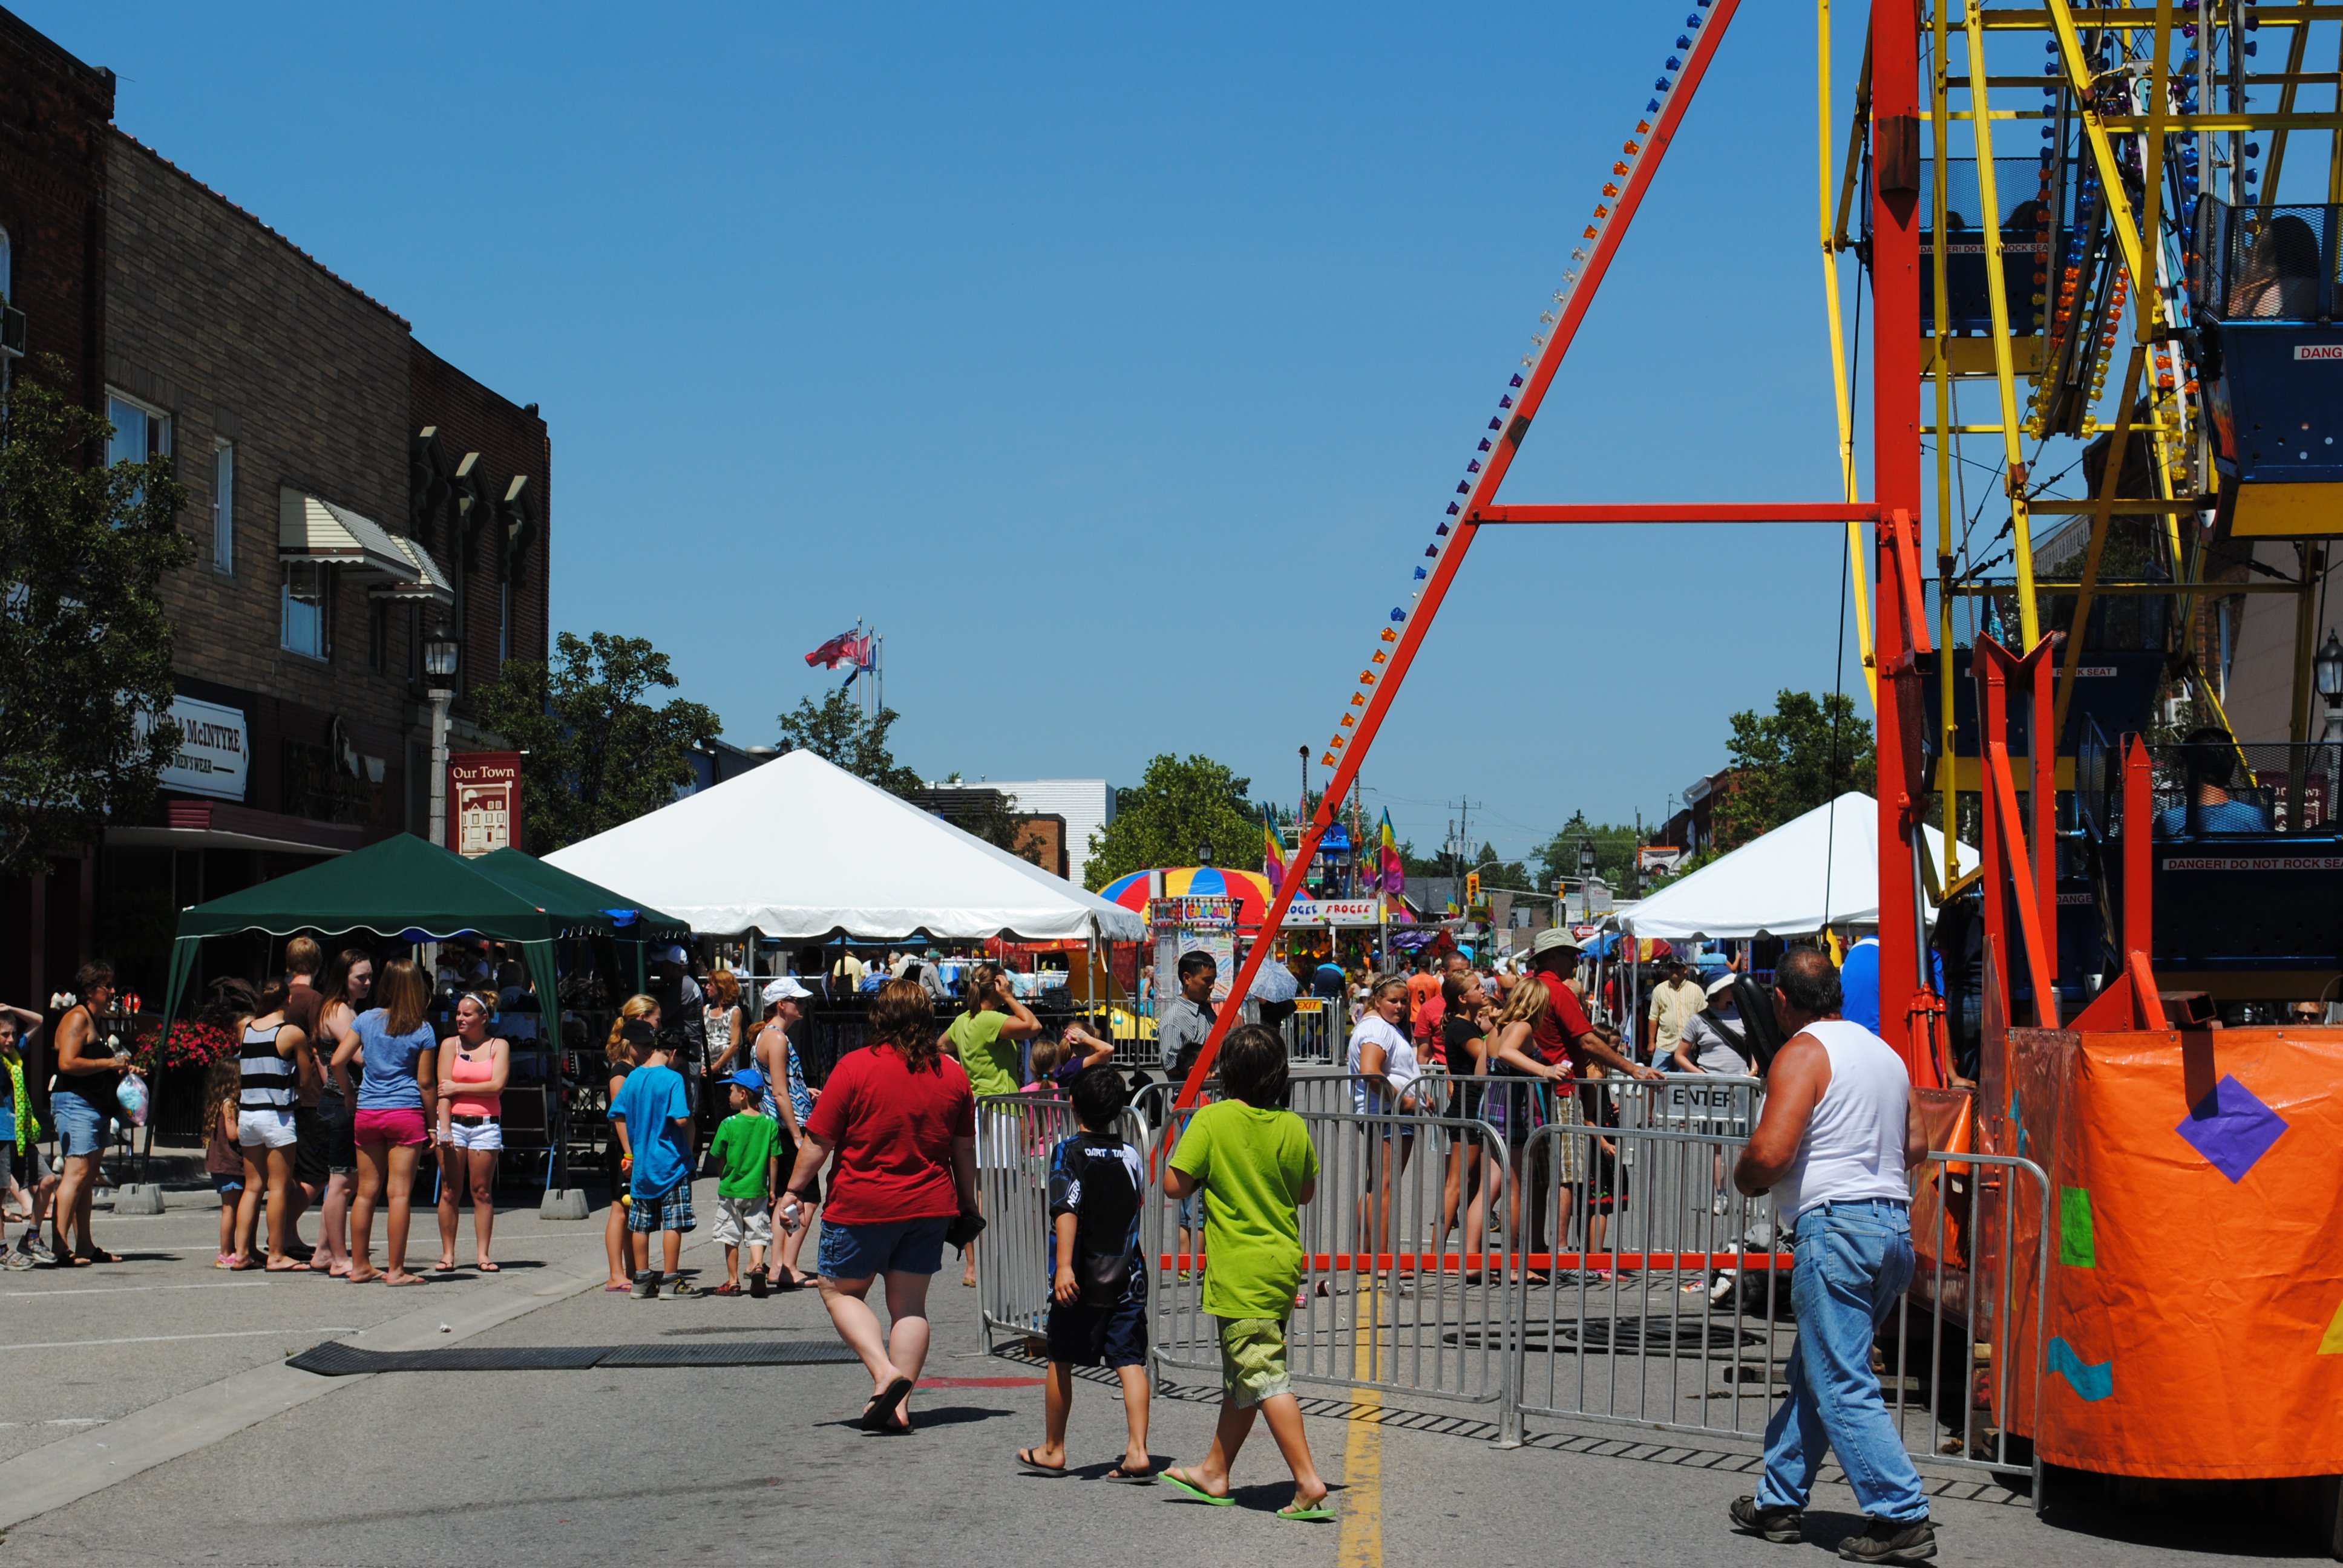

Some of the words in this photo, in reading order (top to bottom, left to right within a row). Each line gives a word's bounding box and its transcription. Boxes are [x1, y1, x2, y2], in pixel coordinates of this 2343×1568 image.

[2301, 347, 2342, 359] DANG
[187, 718, 240, 753] McINTYRE
[174, 753, 194, 771] MEN'S
[194, 757, 212, 774] WEAR
[453, 766, 477, 779] Our
[480, 766, 514, 778] Town
[2168, 860, 2226, 869] DANGER!
[2230, 860, 2249, 869] DO
[2252, 859, 2279, 868] NOT
[2284, 858, 2320, 868] ROCK
[2324, 858, 2343, 867] SE
[1185, 903, 1231, 919] COUPONS
[1286, 904, 1318, 915] OGEE
[1325, 904, 1371, 914] FROGEE
[1417, 990, 1426, 1005] 3
[1297, 1001, 1320, 1010] EXIT
[1673, 1089, 1735, 1108] ENTER
[1084, 1148, 1107, 1158] DART
[1111, 1149, 1128, 1159] TAG
